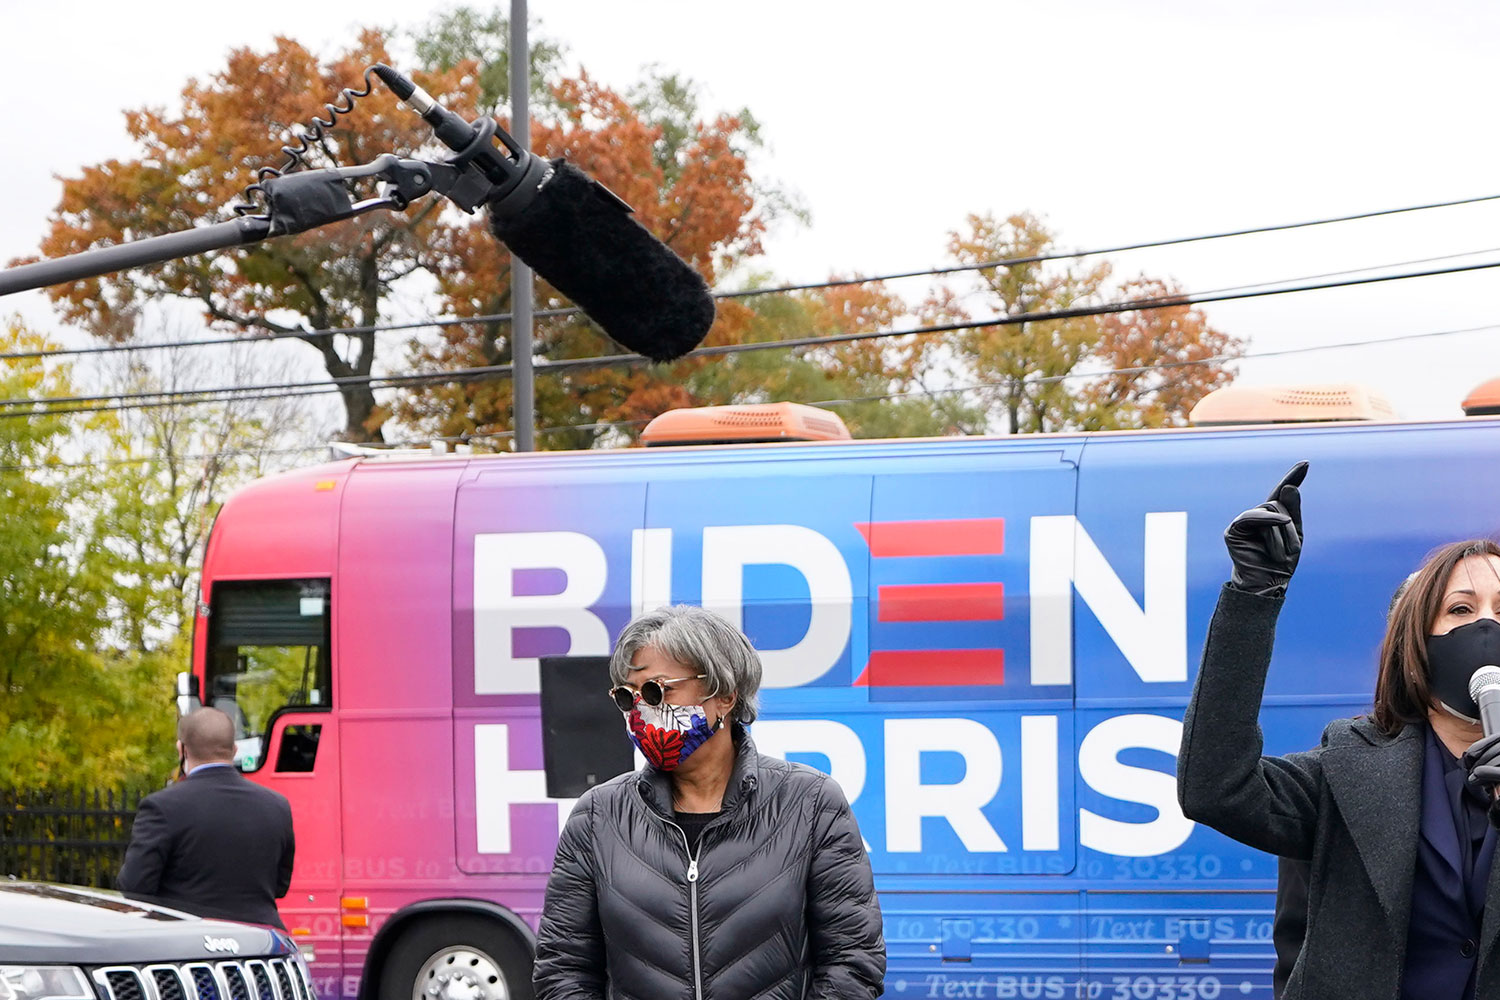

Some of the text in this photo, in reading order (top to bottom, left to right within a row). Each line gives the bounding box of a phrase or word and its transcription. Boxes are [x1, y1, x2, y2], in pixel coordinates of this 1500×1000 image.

[473, 510, 1188, 696] BIDEN
[473, 713, 1195, 859] HRIS
[345, 856, 406, 878] BUS
[414, 857, 441, 878] to
[1112, 854, 1222, 881] 30330
[898, 915, 1040, 942] to 30330
[1090, 917, 1273, 940] Text BUS to
[203, 935, 239, 955] Jeep
[925, 974, 987, 999] Text
[996, 976, 1065, 999] BUS
[1075, 975, 1101, 999] to
